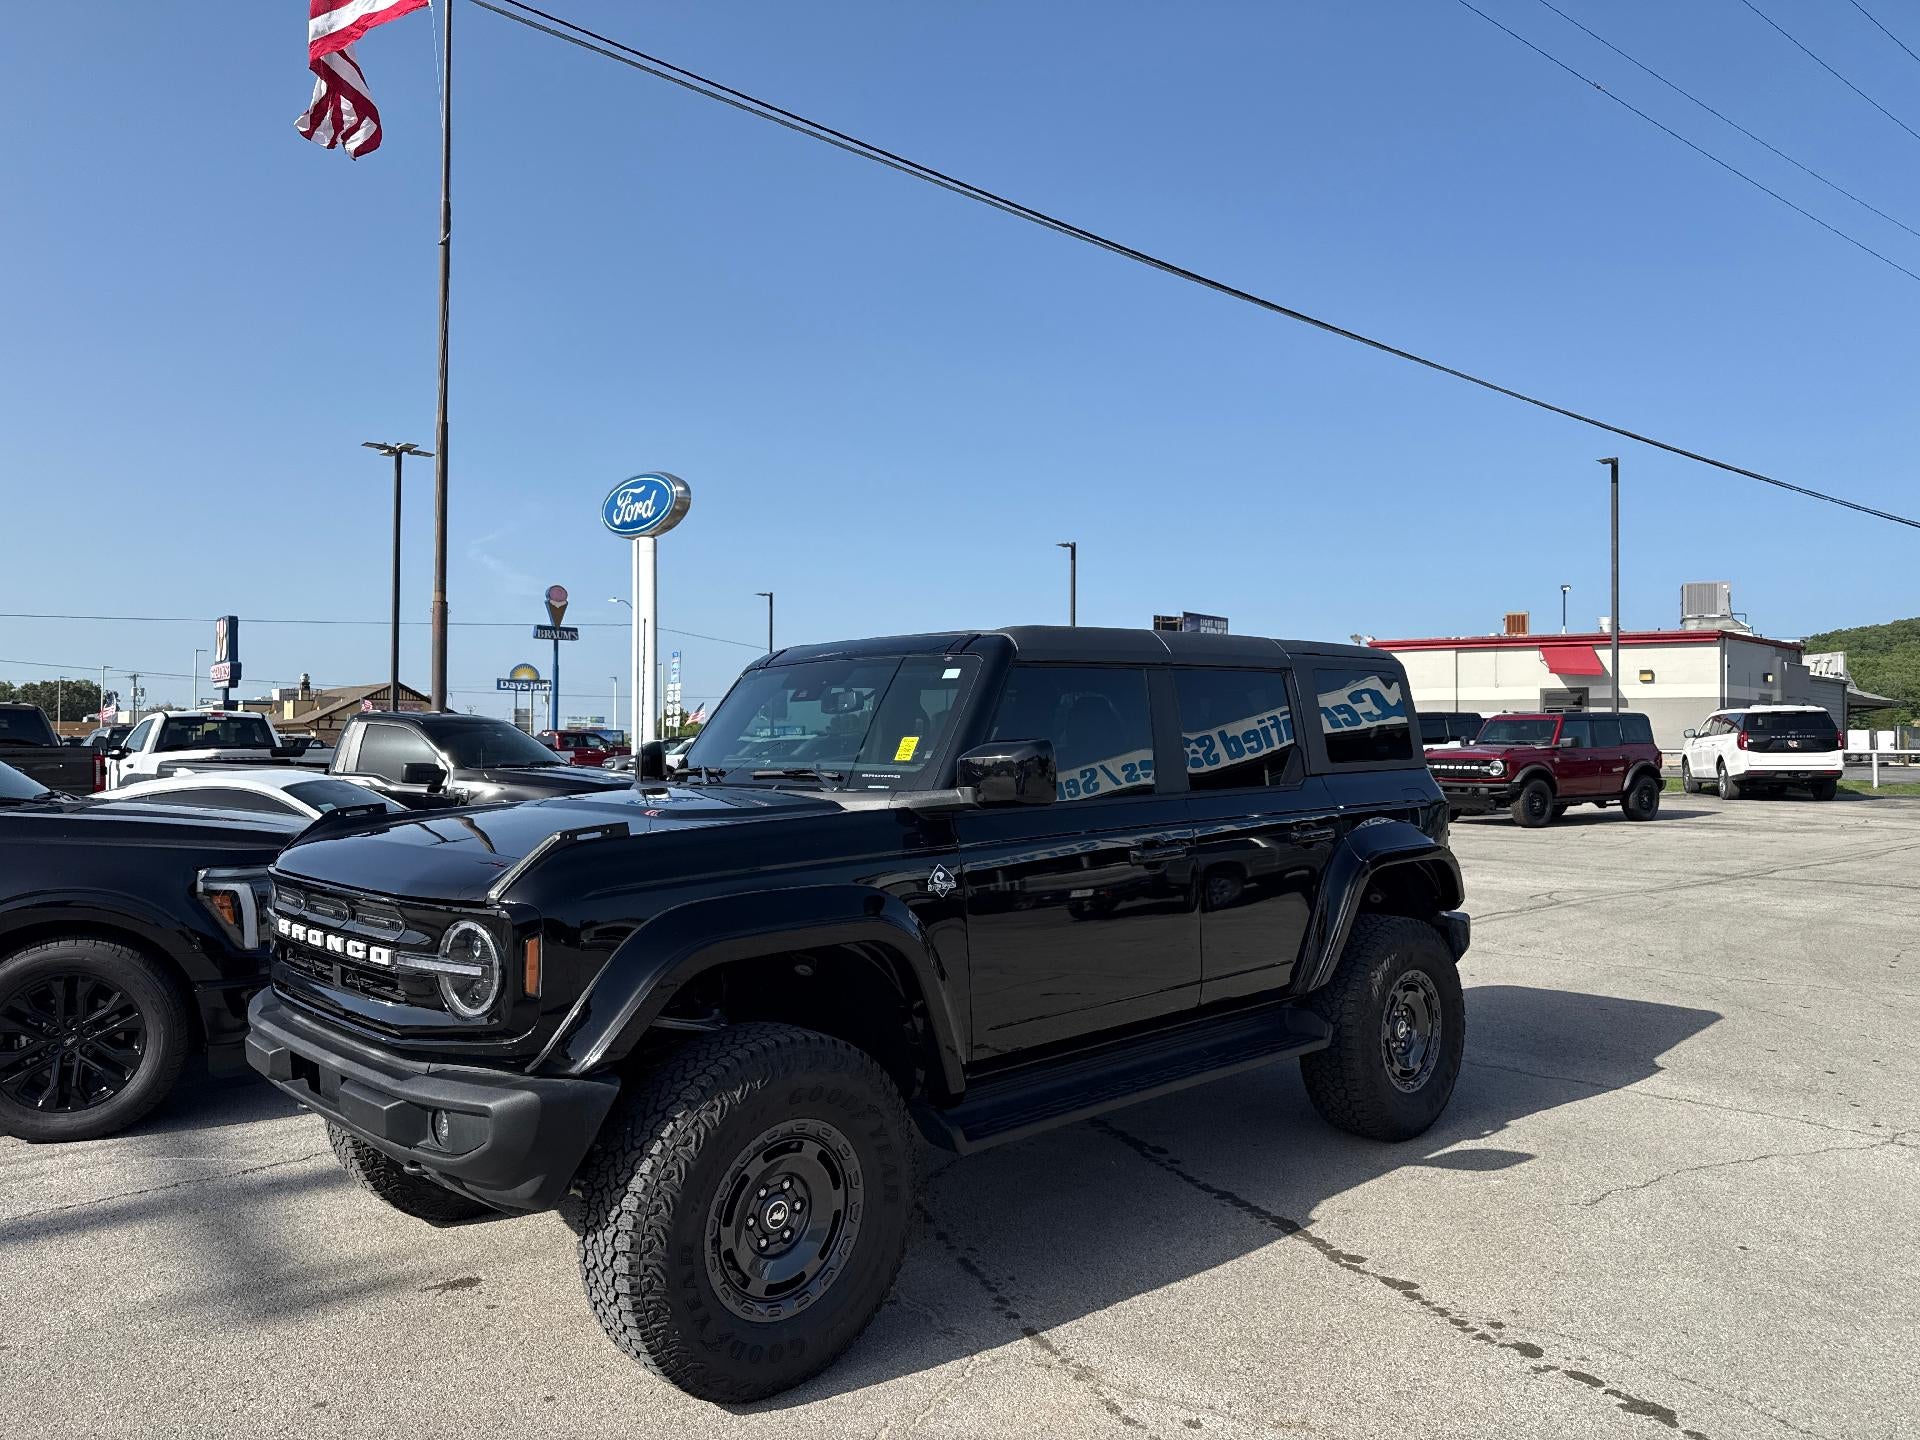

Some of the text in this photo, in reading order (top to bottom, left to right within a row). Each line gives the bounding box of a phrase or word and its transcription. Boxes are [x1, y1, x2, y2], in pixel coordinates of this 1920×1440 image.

[612, 485, 657, 525] Ford
[536, 629, 578, 640] BRAUM'S
[500, 680, 529, 690] Days
[278, 918, 392, 966] BRONCO
